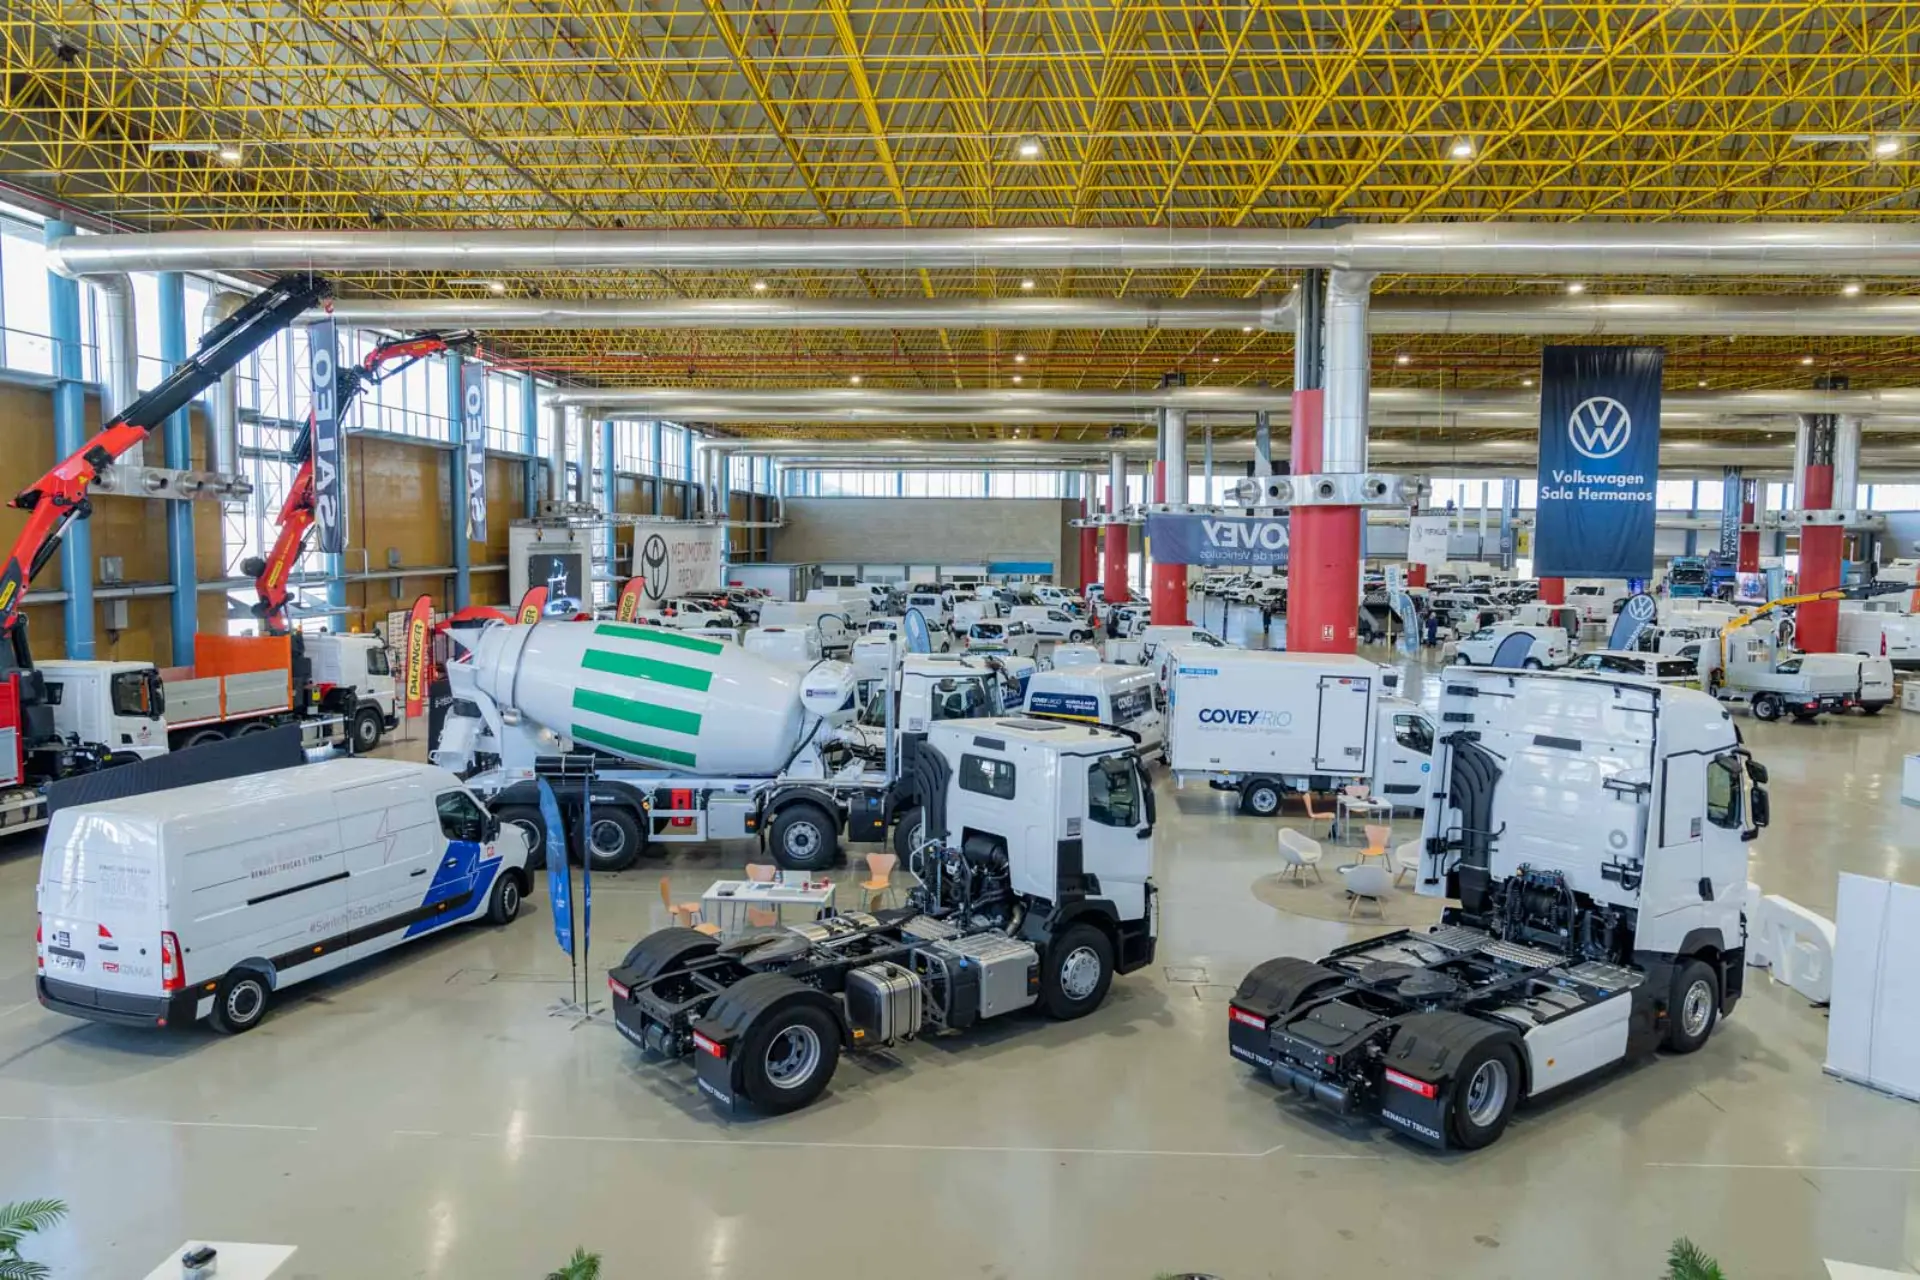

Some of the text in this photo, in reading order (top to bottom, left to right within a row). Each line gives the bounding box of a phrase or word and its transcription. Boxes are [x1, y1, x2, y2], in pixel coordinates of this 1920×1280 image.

[1552, 469, 1644, 487] Volkswagen
[1541, 486, 1653, 502] Sala Hermanos
[1382, 1108, 1440, 1140] RENAULT TRUCKS
